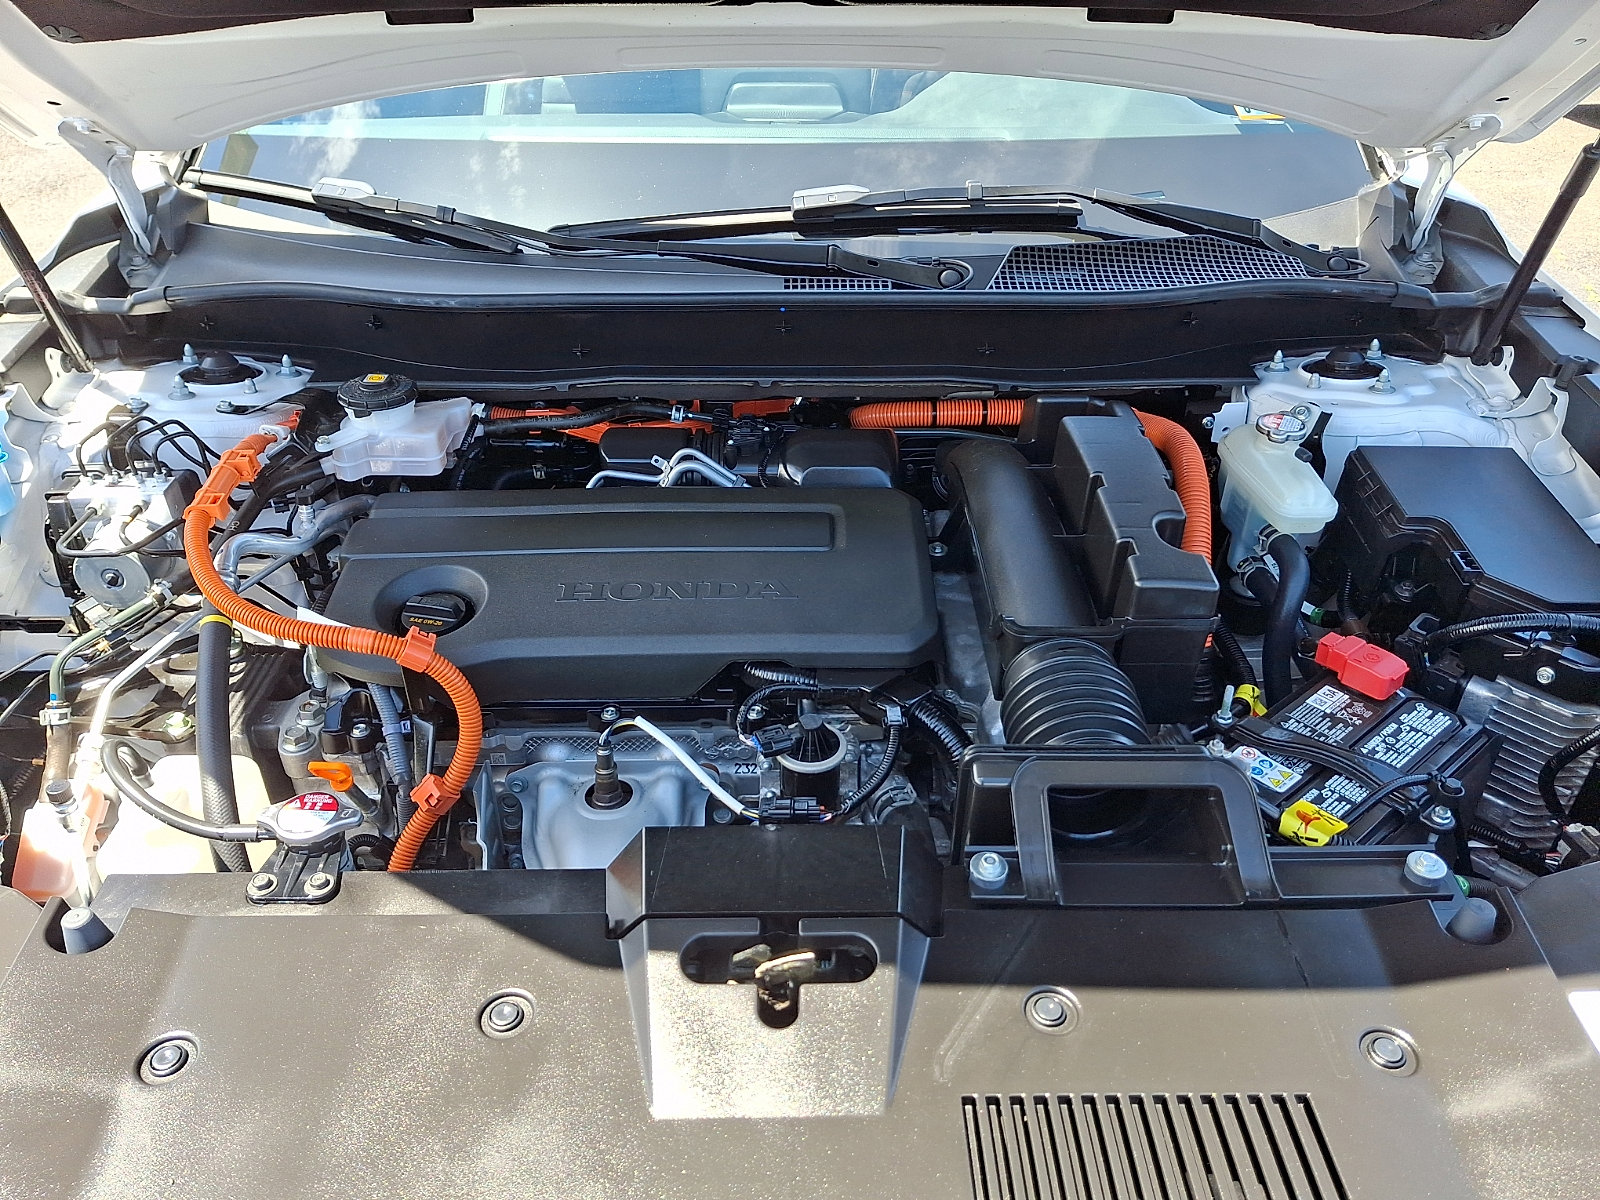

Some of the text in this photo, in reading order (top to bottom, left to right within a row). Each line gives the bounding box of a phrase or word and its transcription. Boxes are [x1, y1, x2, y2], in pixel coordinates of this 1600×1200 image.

[555, 580, 799, 602] HONDA
[1322, 688, 1340, 699] 5A
[734, 762, 758, 775] 232
